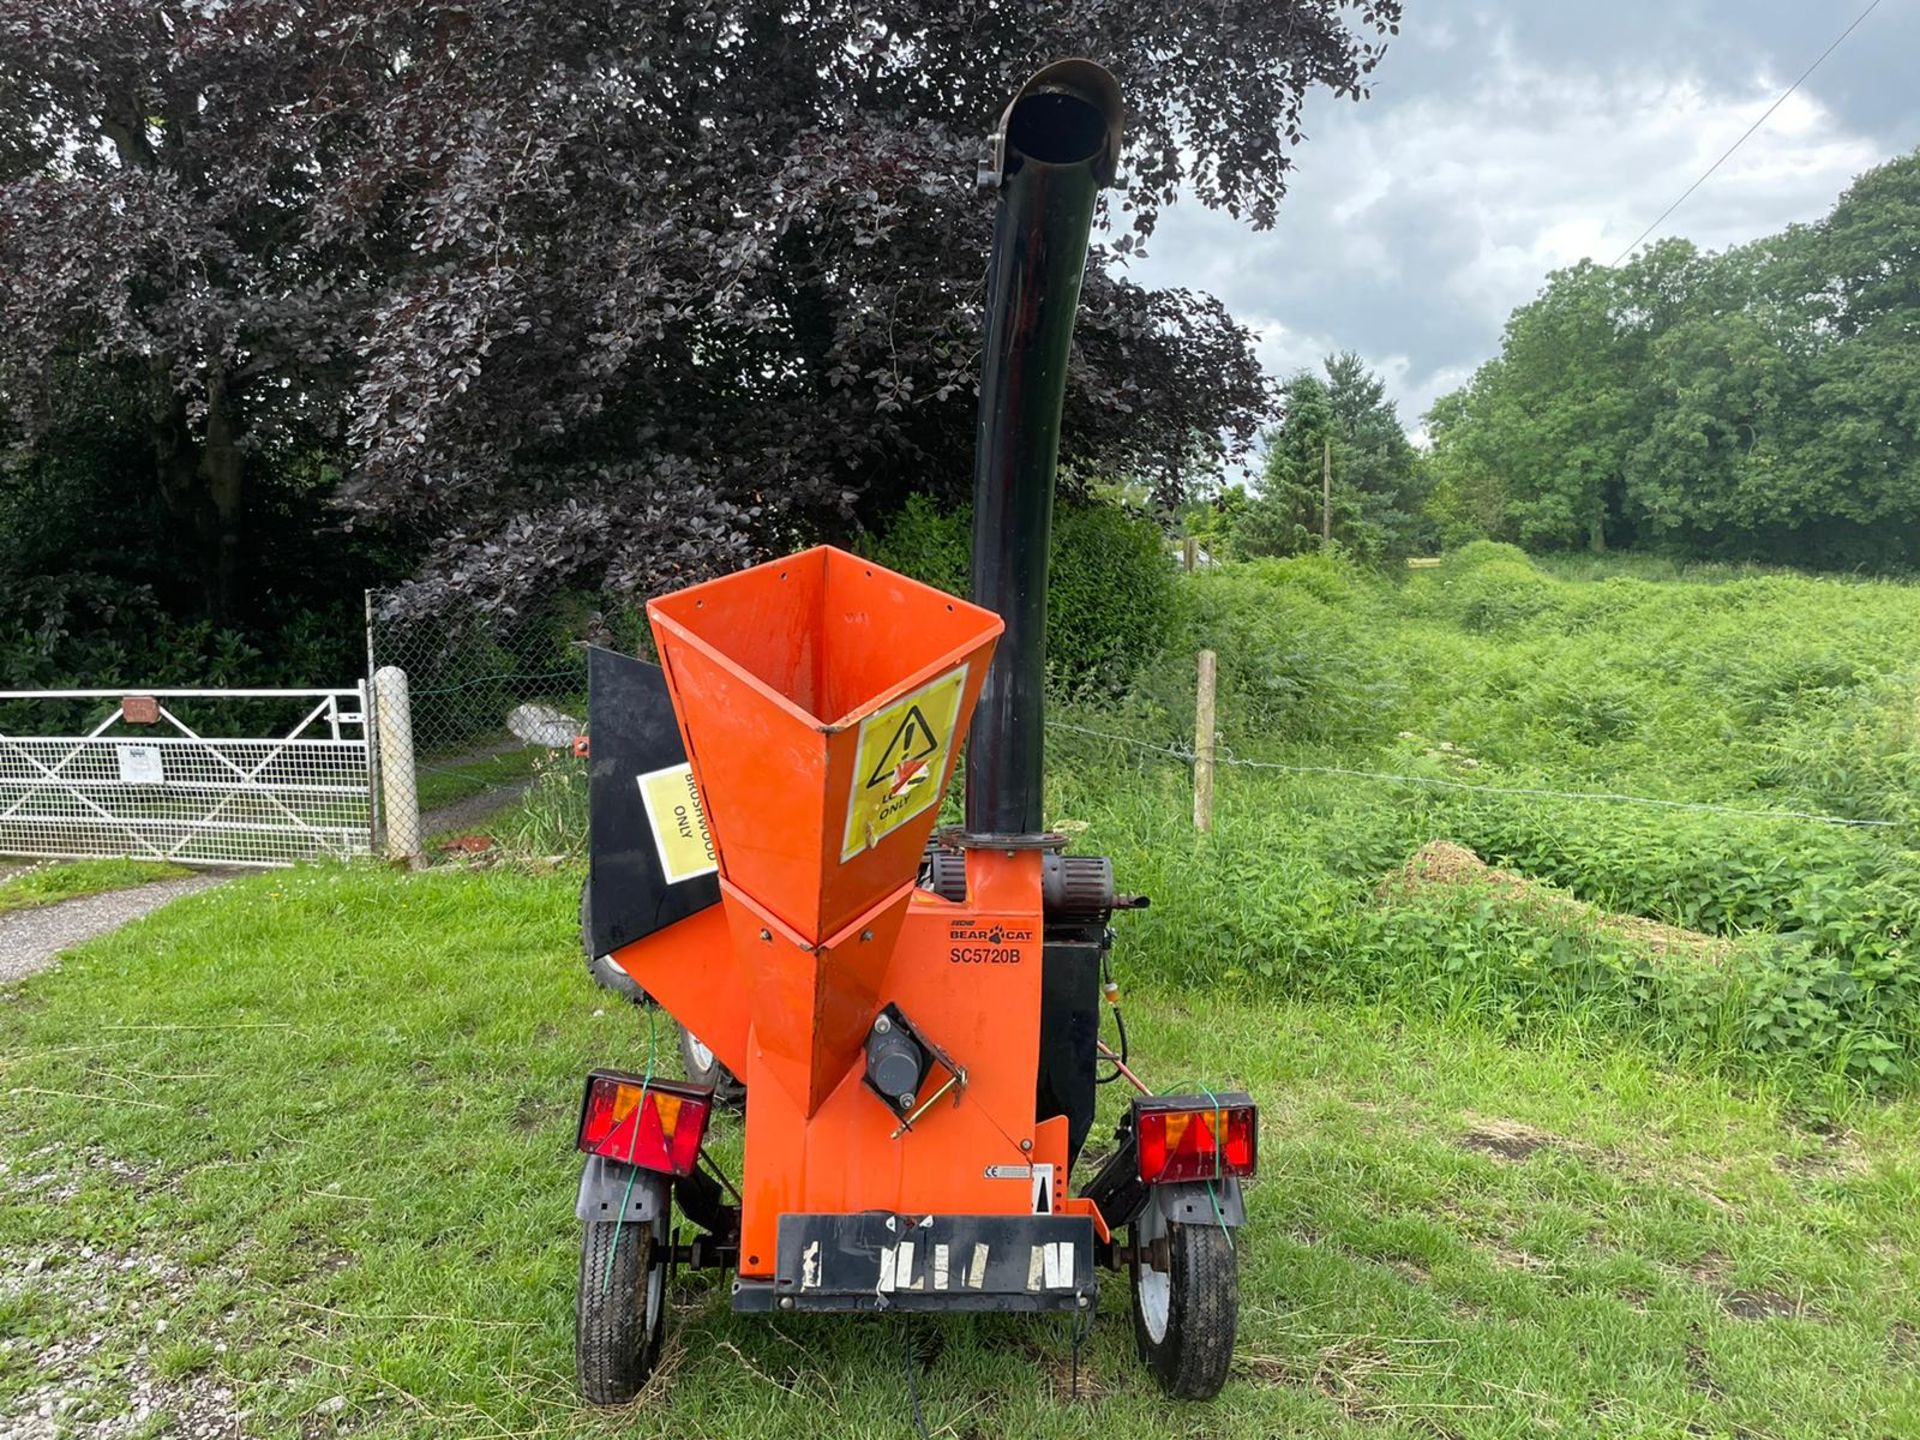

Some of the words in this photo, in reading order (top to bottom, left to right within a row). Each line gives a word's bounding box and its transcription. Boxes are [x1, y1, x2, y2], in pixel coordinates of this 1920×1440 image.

[880, 793, 911, 820] ONLY
[674, 805, 693, 839] ONLY
[950, 931, 987, 939] BEAR
[1006, 931, 1032, 940] CAT
[950, 948, 1021, 963] SC5720B
